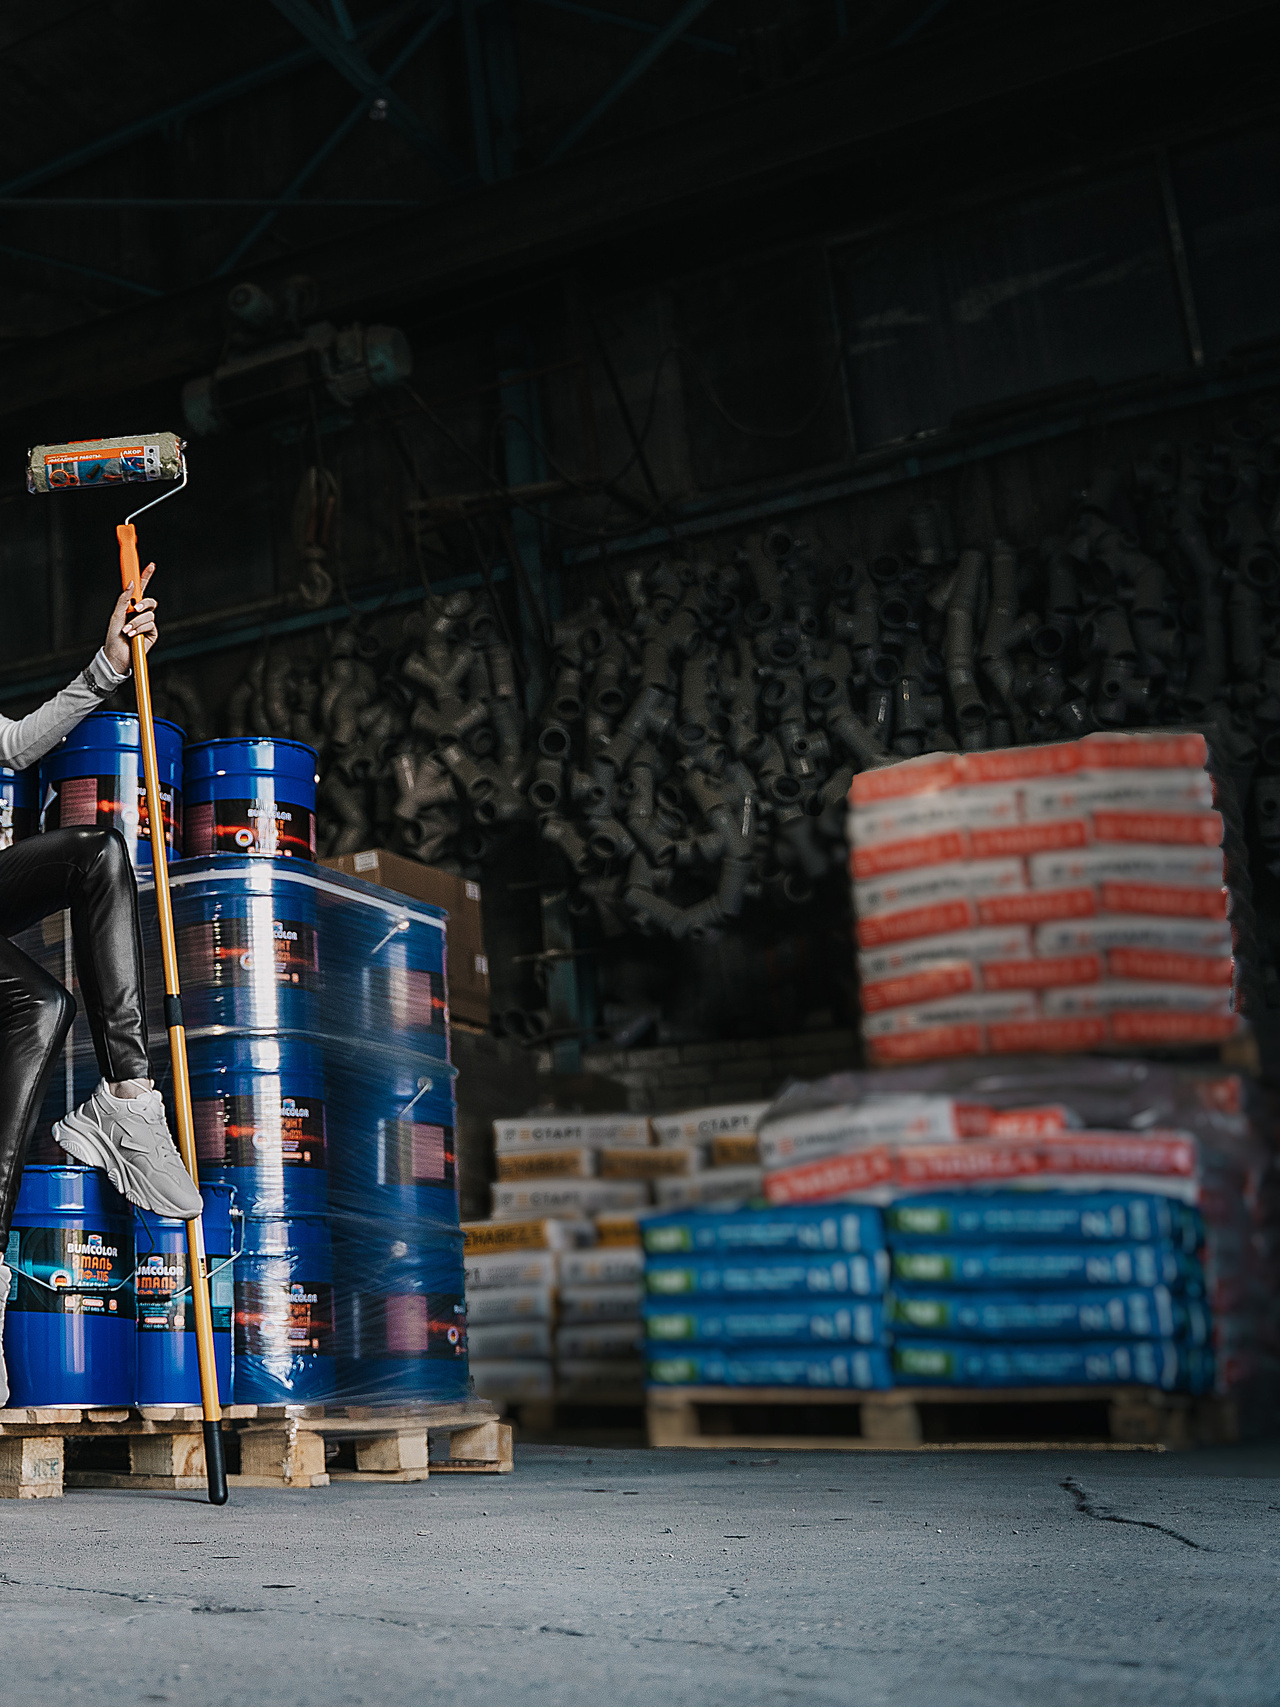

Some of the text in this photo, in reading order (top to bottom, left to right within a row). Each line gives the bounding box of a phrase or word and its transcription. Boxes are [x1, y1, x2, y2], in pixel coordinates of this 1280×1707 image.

[273, 929, 298, 940] COLOR
[66, 1243, 118, 1257] BUMCOLOR
[71, 1254, 113, 1271] ЭМАЛЬ
[135, 1265, 184, 1276] UMCOLOR
